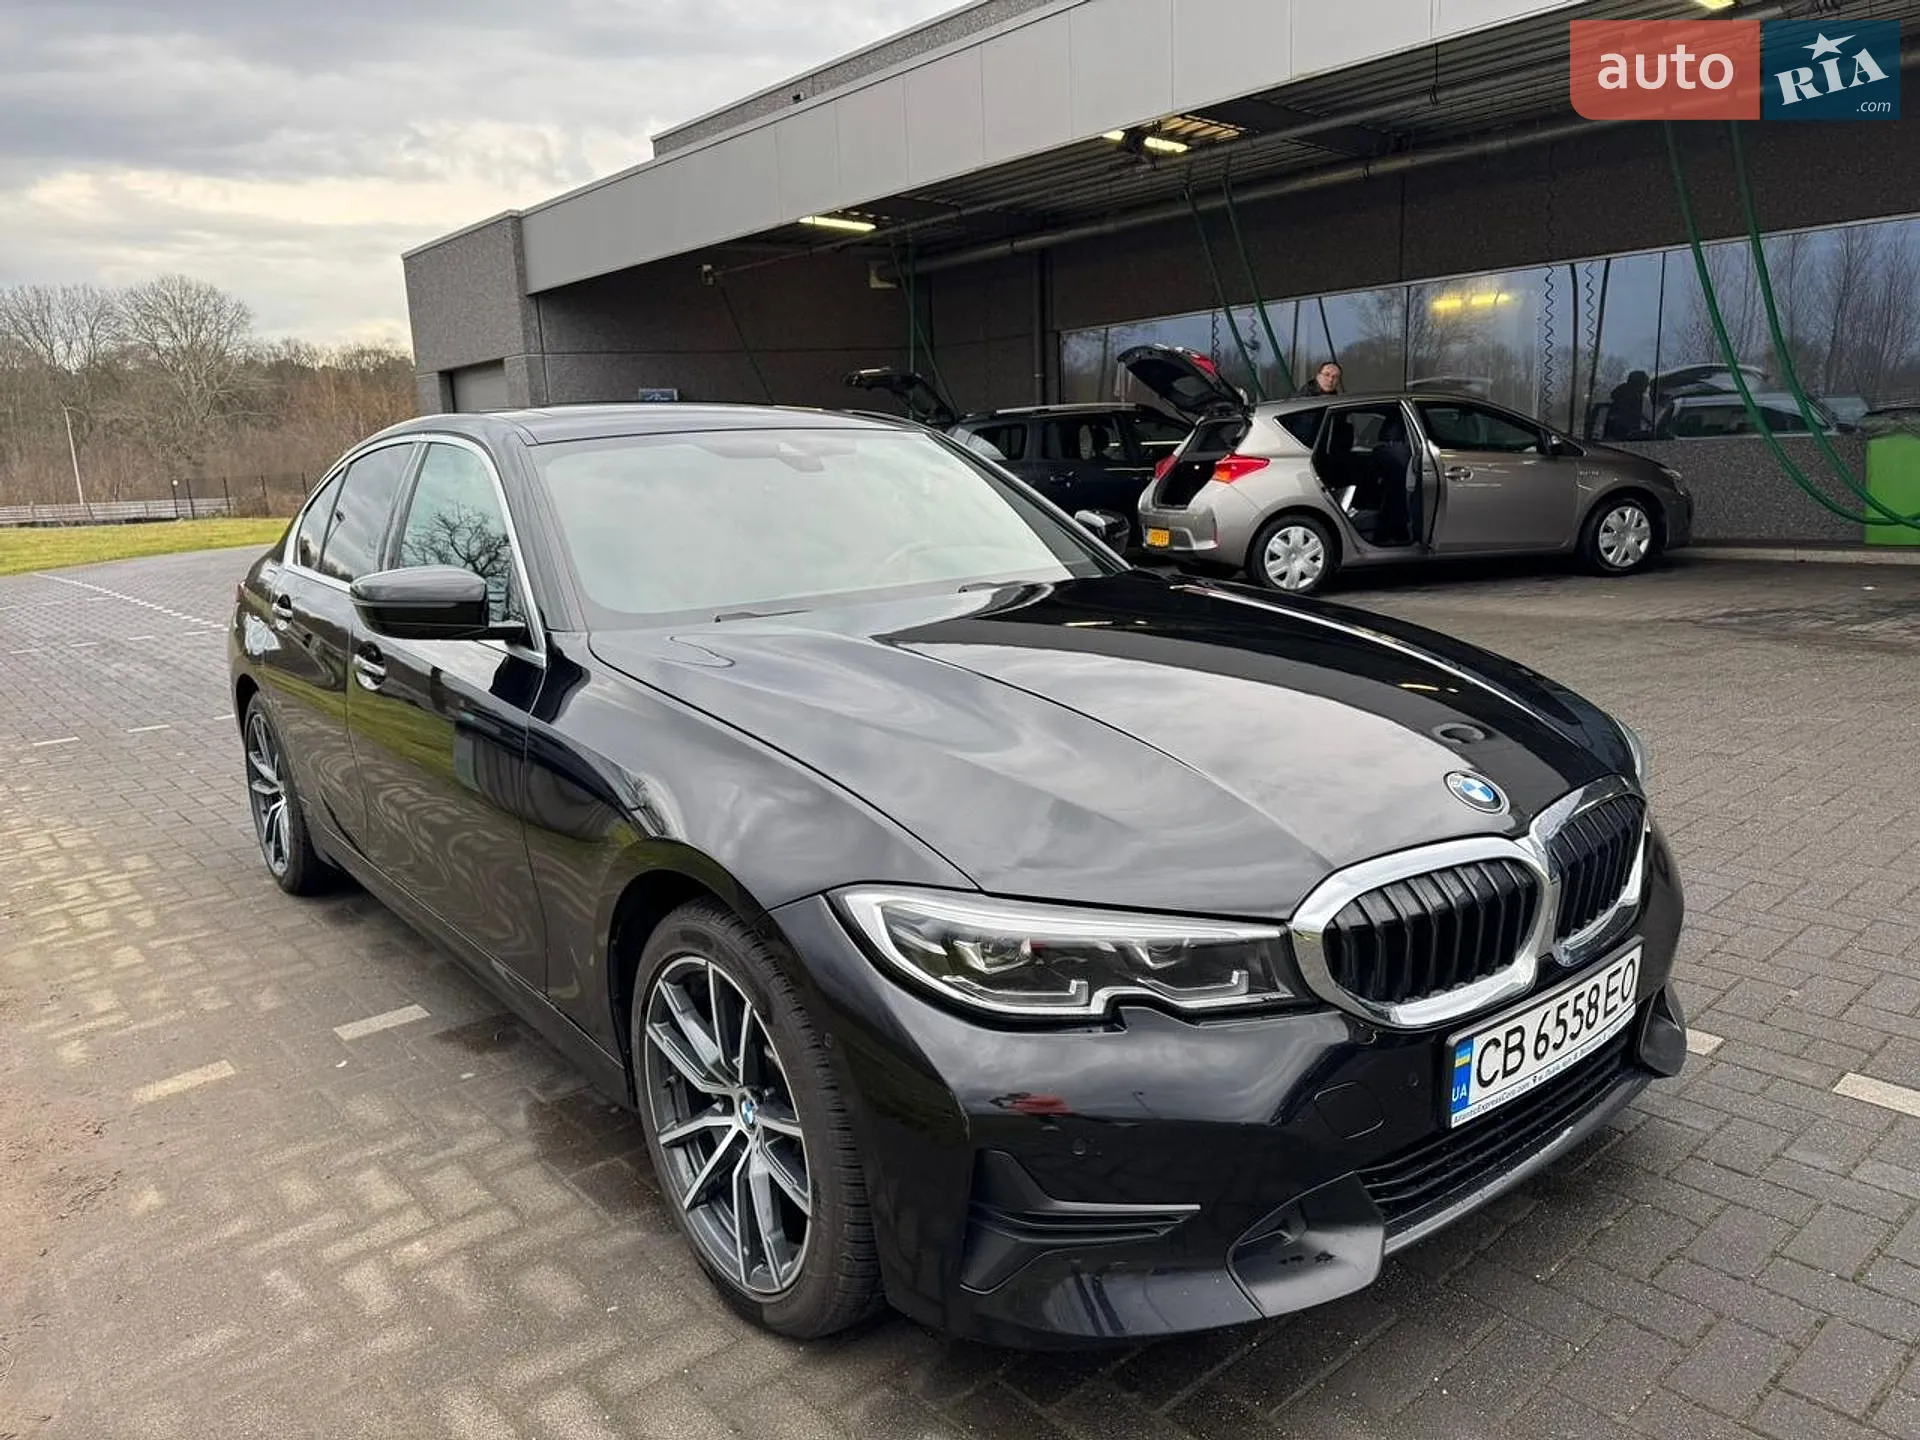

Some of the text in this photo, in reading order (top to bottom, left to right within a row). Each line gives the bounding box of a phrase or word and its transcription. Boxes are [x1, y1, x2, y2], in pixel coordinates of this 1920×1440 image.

[1476, 1025, 1526, 1089] CB
[1534, 983, 1601, 1061] 6558
[1604, 958, 1636, 1019] EO
[1452, 1083, 1468, 1102] UA
